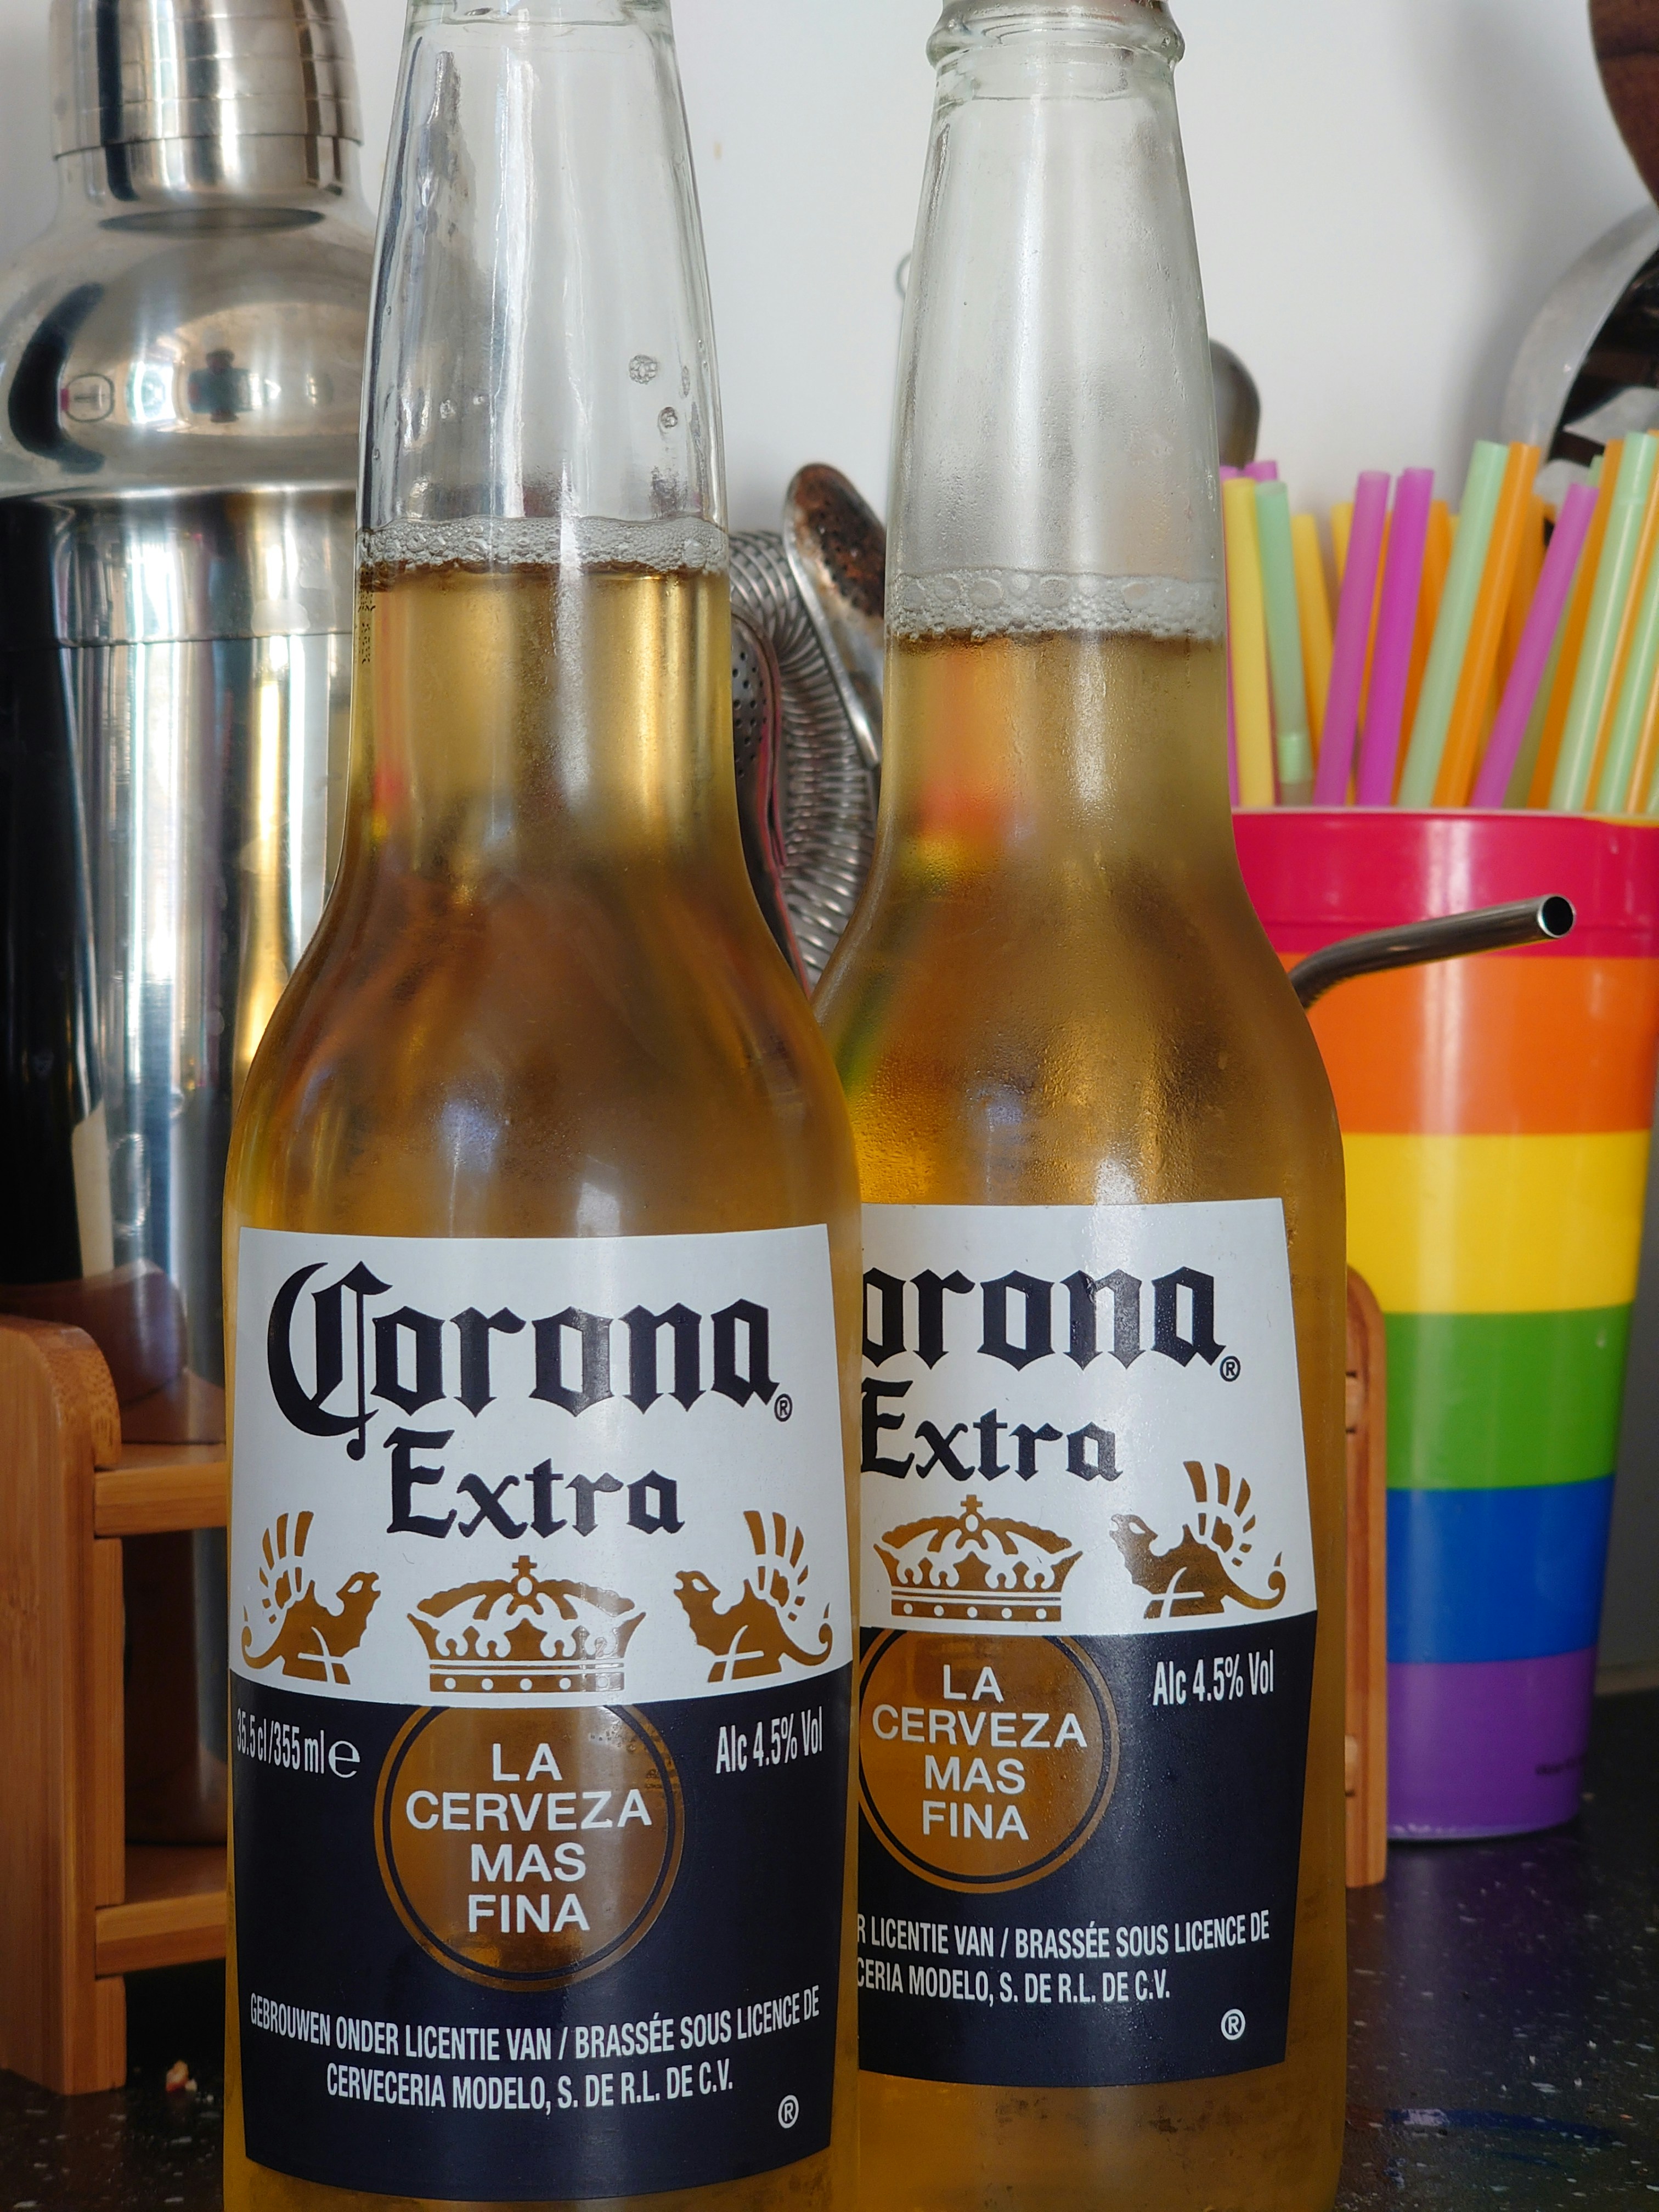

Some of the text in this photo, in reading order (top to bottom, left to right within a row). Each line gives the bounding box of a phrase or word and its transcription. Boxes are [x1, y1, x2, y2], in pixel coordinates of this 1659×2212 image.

[857, 1376, 1122, 1482] Extra
[382, 1426, 685, 1540] Extra
[943, 1664, 1005, 1703] LA
[1153, 1649, 1273, 1706] Alc 4.5% Vol
[716, 1706, 822, 1774] Alc 4.5% Vol
[873, 1705, 1088, 1748] CERVEZA
[493, 1743, 563, 1781] LA
[925, 1755, 1025, 1795] MAS
[406, 1788, 652, 1831] CERVEZA
[923, 1800, 1029, 1840] FINA
[471, 1842, 587, 1882] MAS
[469, 1893, 591, 1933] FINA
[871, 1916, 949, 1954] LICENTIE
[954, 1925, 994, 1957] VAN
[1015, 1921, 1110, 1959] BRASSÉE
[1116, 1924, 1169, 1958] SOUS
[1175, 1914, 1246, 1953] LICENCE
[1250, 1909, 1269, 1942] DE
[909, 1965, 994, 2007] MODELO,
[1000, 1972, 1018, 2002] S.
[1025, 1973, 1052, 2003] DE
[1058, 1973, 1096, 2004] R.L.
[1102, 1971, 1129, 2003] DE
[1135, 1968, 1170, 2001] C.V.
[251, 1993, 330, 2046] GEBROUWEN
[336, 2016, 399, 2056] ONDER
[405, 2024, 500, 2061] LICENTIE
[506, 2028, 551, 2061] VAN
[575, 2012, 674, 2059] BRASSÉE
[680, 2010, 732, 2049] SOUS
[737, 1993, 800, 2040] LICENCE
[804, 1985, 820, 2021] DE
[327, 2058, 733, 2115] CERVECERIA MODELO, S. DE R.L. DE C.V.
